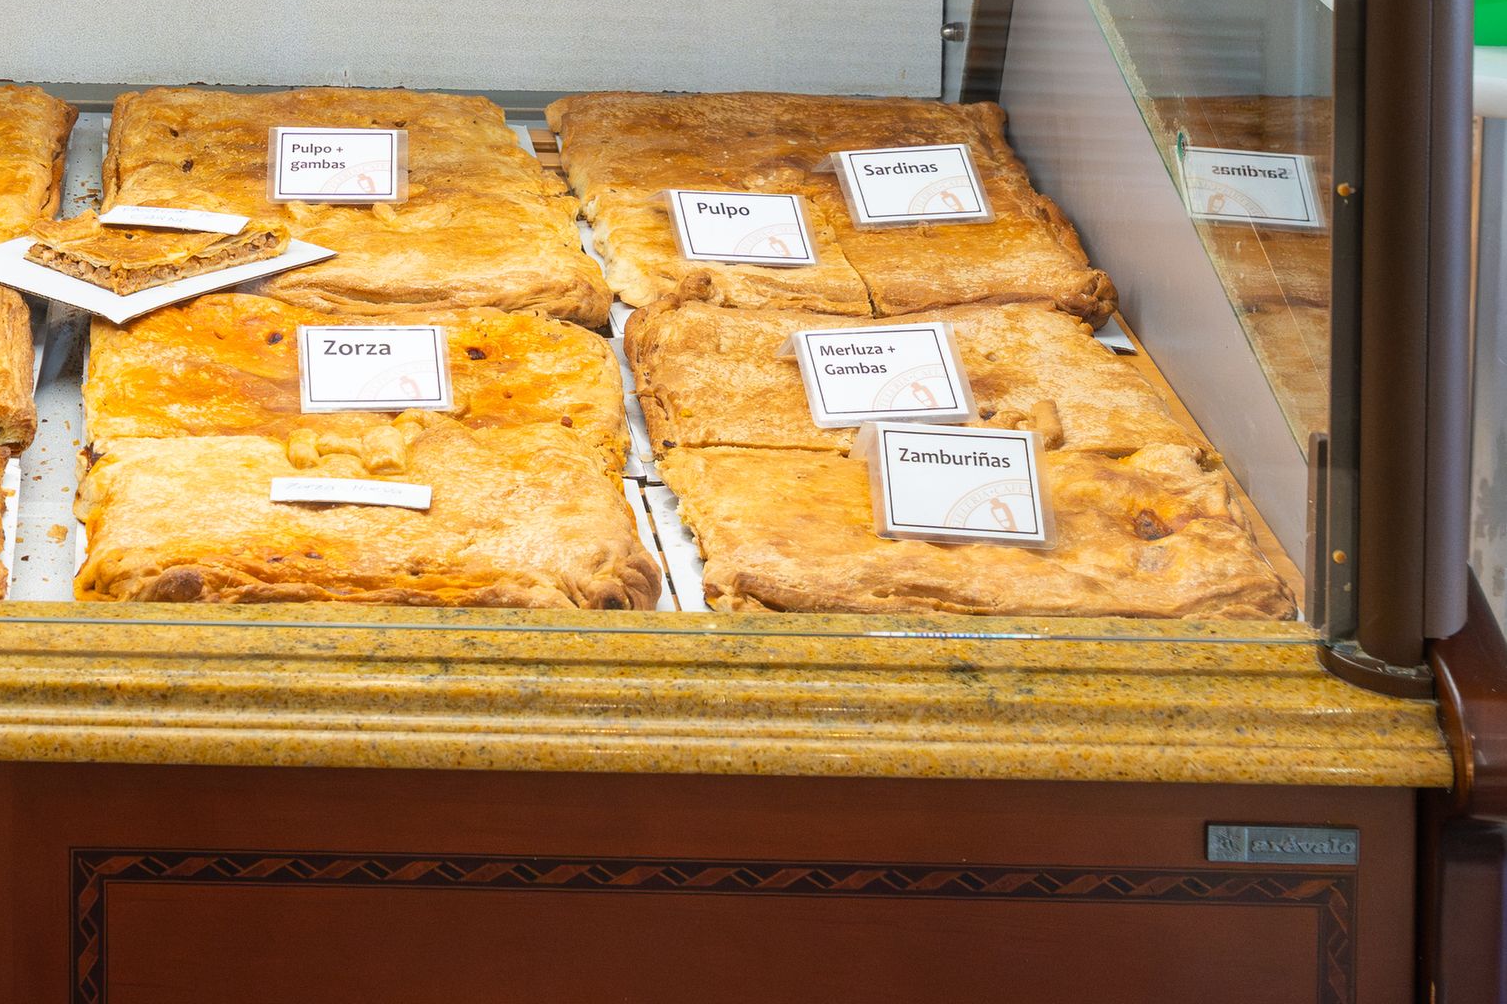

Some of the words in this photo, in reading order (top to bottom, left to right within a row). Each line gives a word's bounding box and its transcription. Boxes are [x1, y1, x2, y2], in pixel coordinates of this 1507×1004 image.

[292, 143, 332, 156] Pulpo
[290, 159, 346, 172] gambas
[863, 162, 939, 176] Sardinas
[697, 202, 750, 218] Pulpo
[323, 340, 391, 356] Zorza
[820, 344, 883, 356] Merluza
[887, 345, 896, 353] +
[824, 362, 887, 375] Gambas
[899, 447, 1011, 468] Zamburiñas
